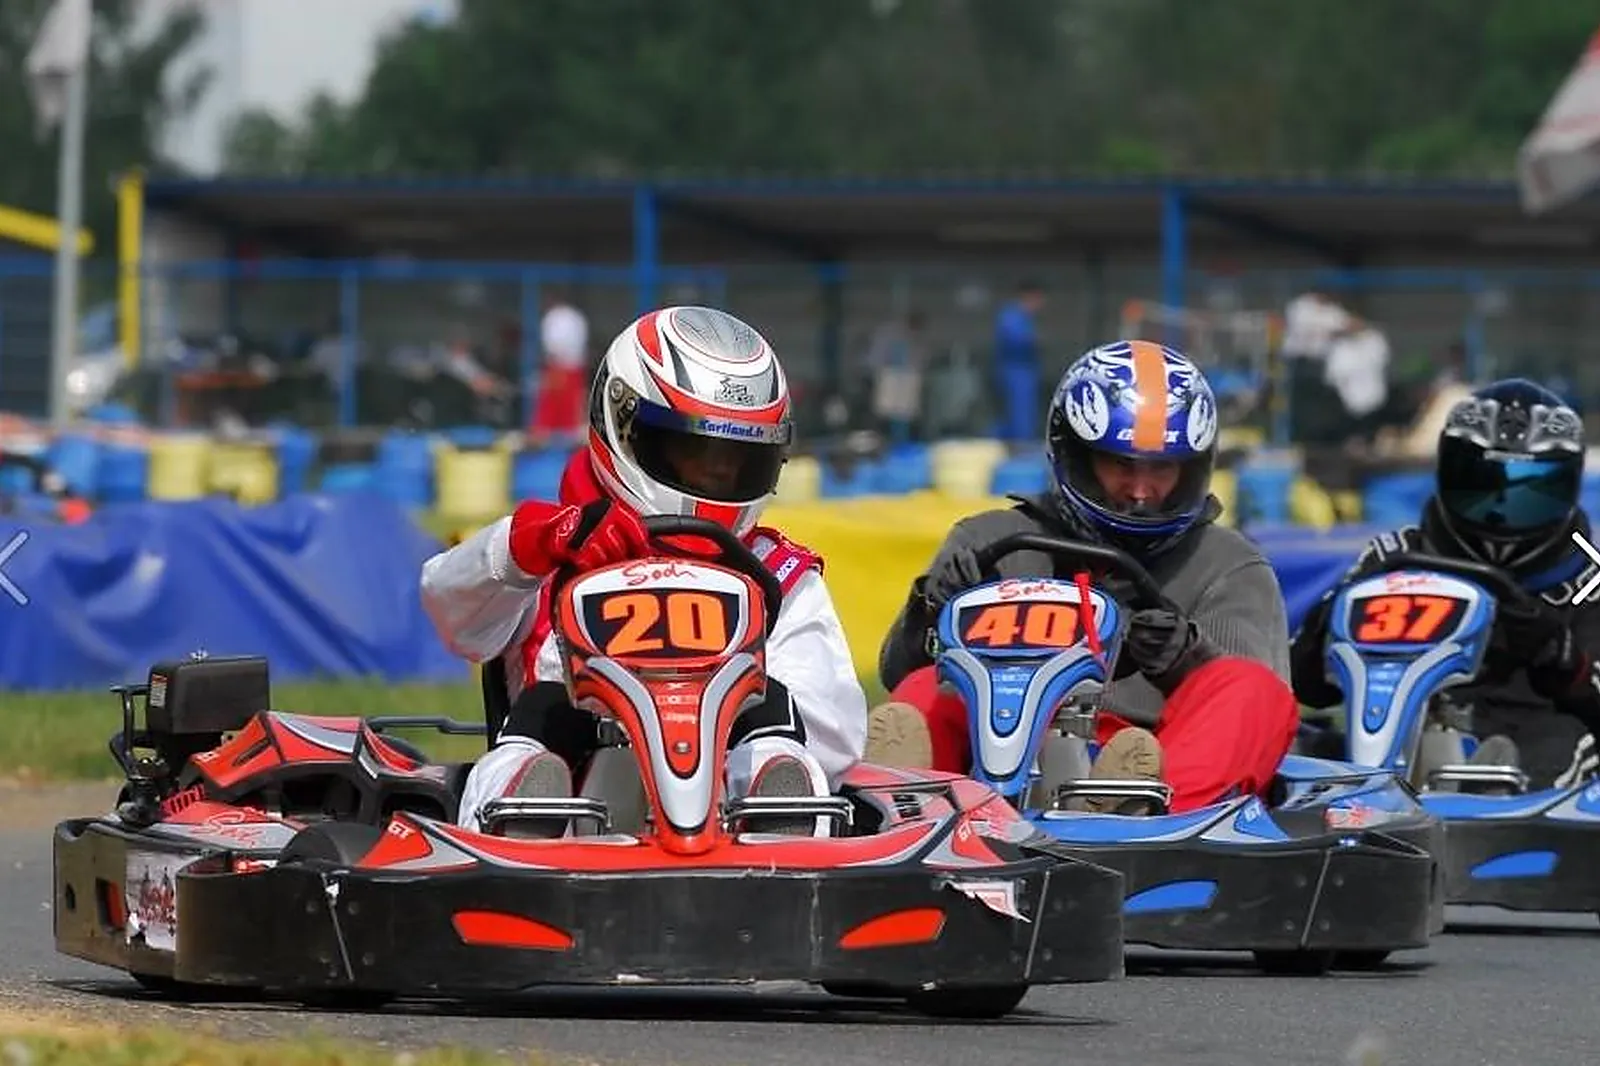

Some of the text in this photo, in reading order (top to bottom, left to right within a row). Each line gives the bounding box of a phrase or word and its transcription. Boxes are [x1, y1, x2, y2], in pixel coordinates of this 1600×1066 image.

[603, 593, 726, 656] 20
[965, 603, 1079, 647] 40
[1357, 596, 1457, 641] 37
[388, 821, 415, 839] GT
